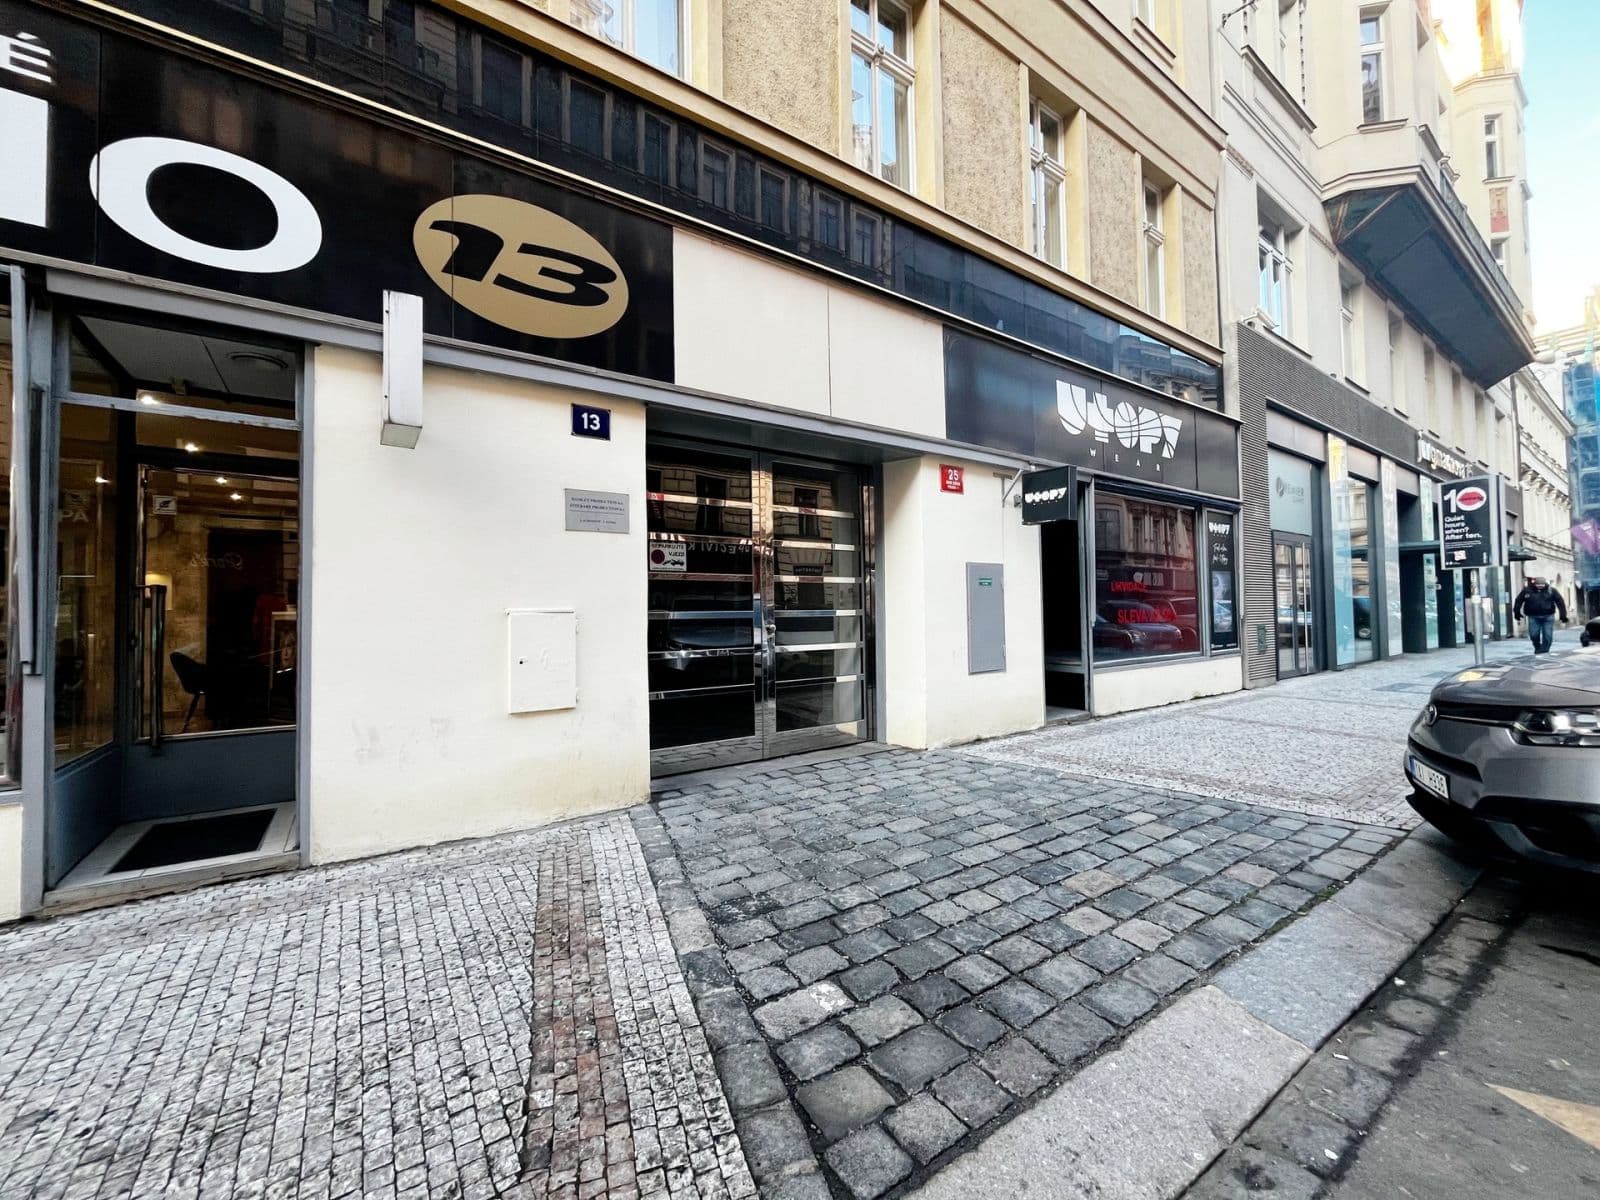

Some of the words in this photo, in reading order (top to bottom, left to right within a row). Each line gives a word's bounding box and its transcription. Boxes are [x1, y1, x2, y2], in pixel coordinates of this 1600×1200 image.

[428, 219, 618, 307] 13
[581, 412, 601, 430] 13
[1089, 446, 1161, 472] WEAR
[948, 469, 959, 480] 25
[1444, 526, 1470, 534] when?
